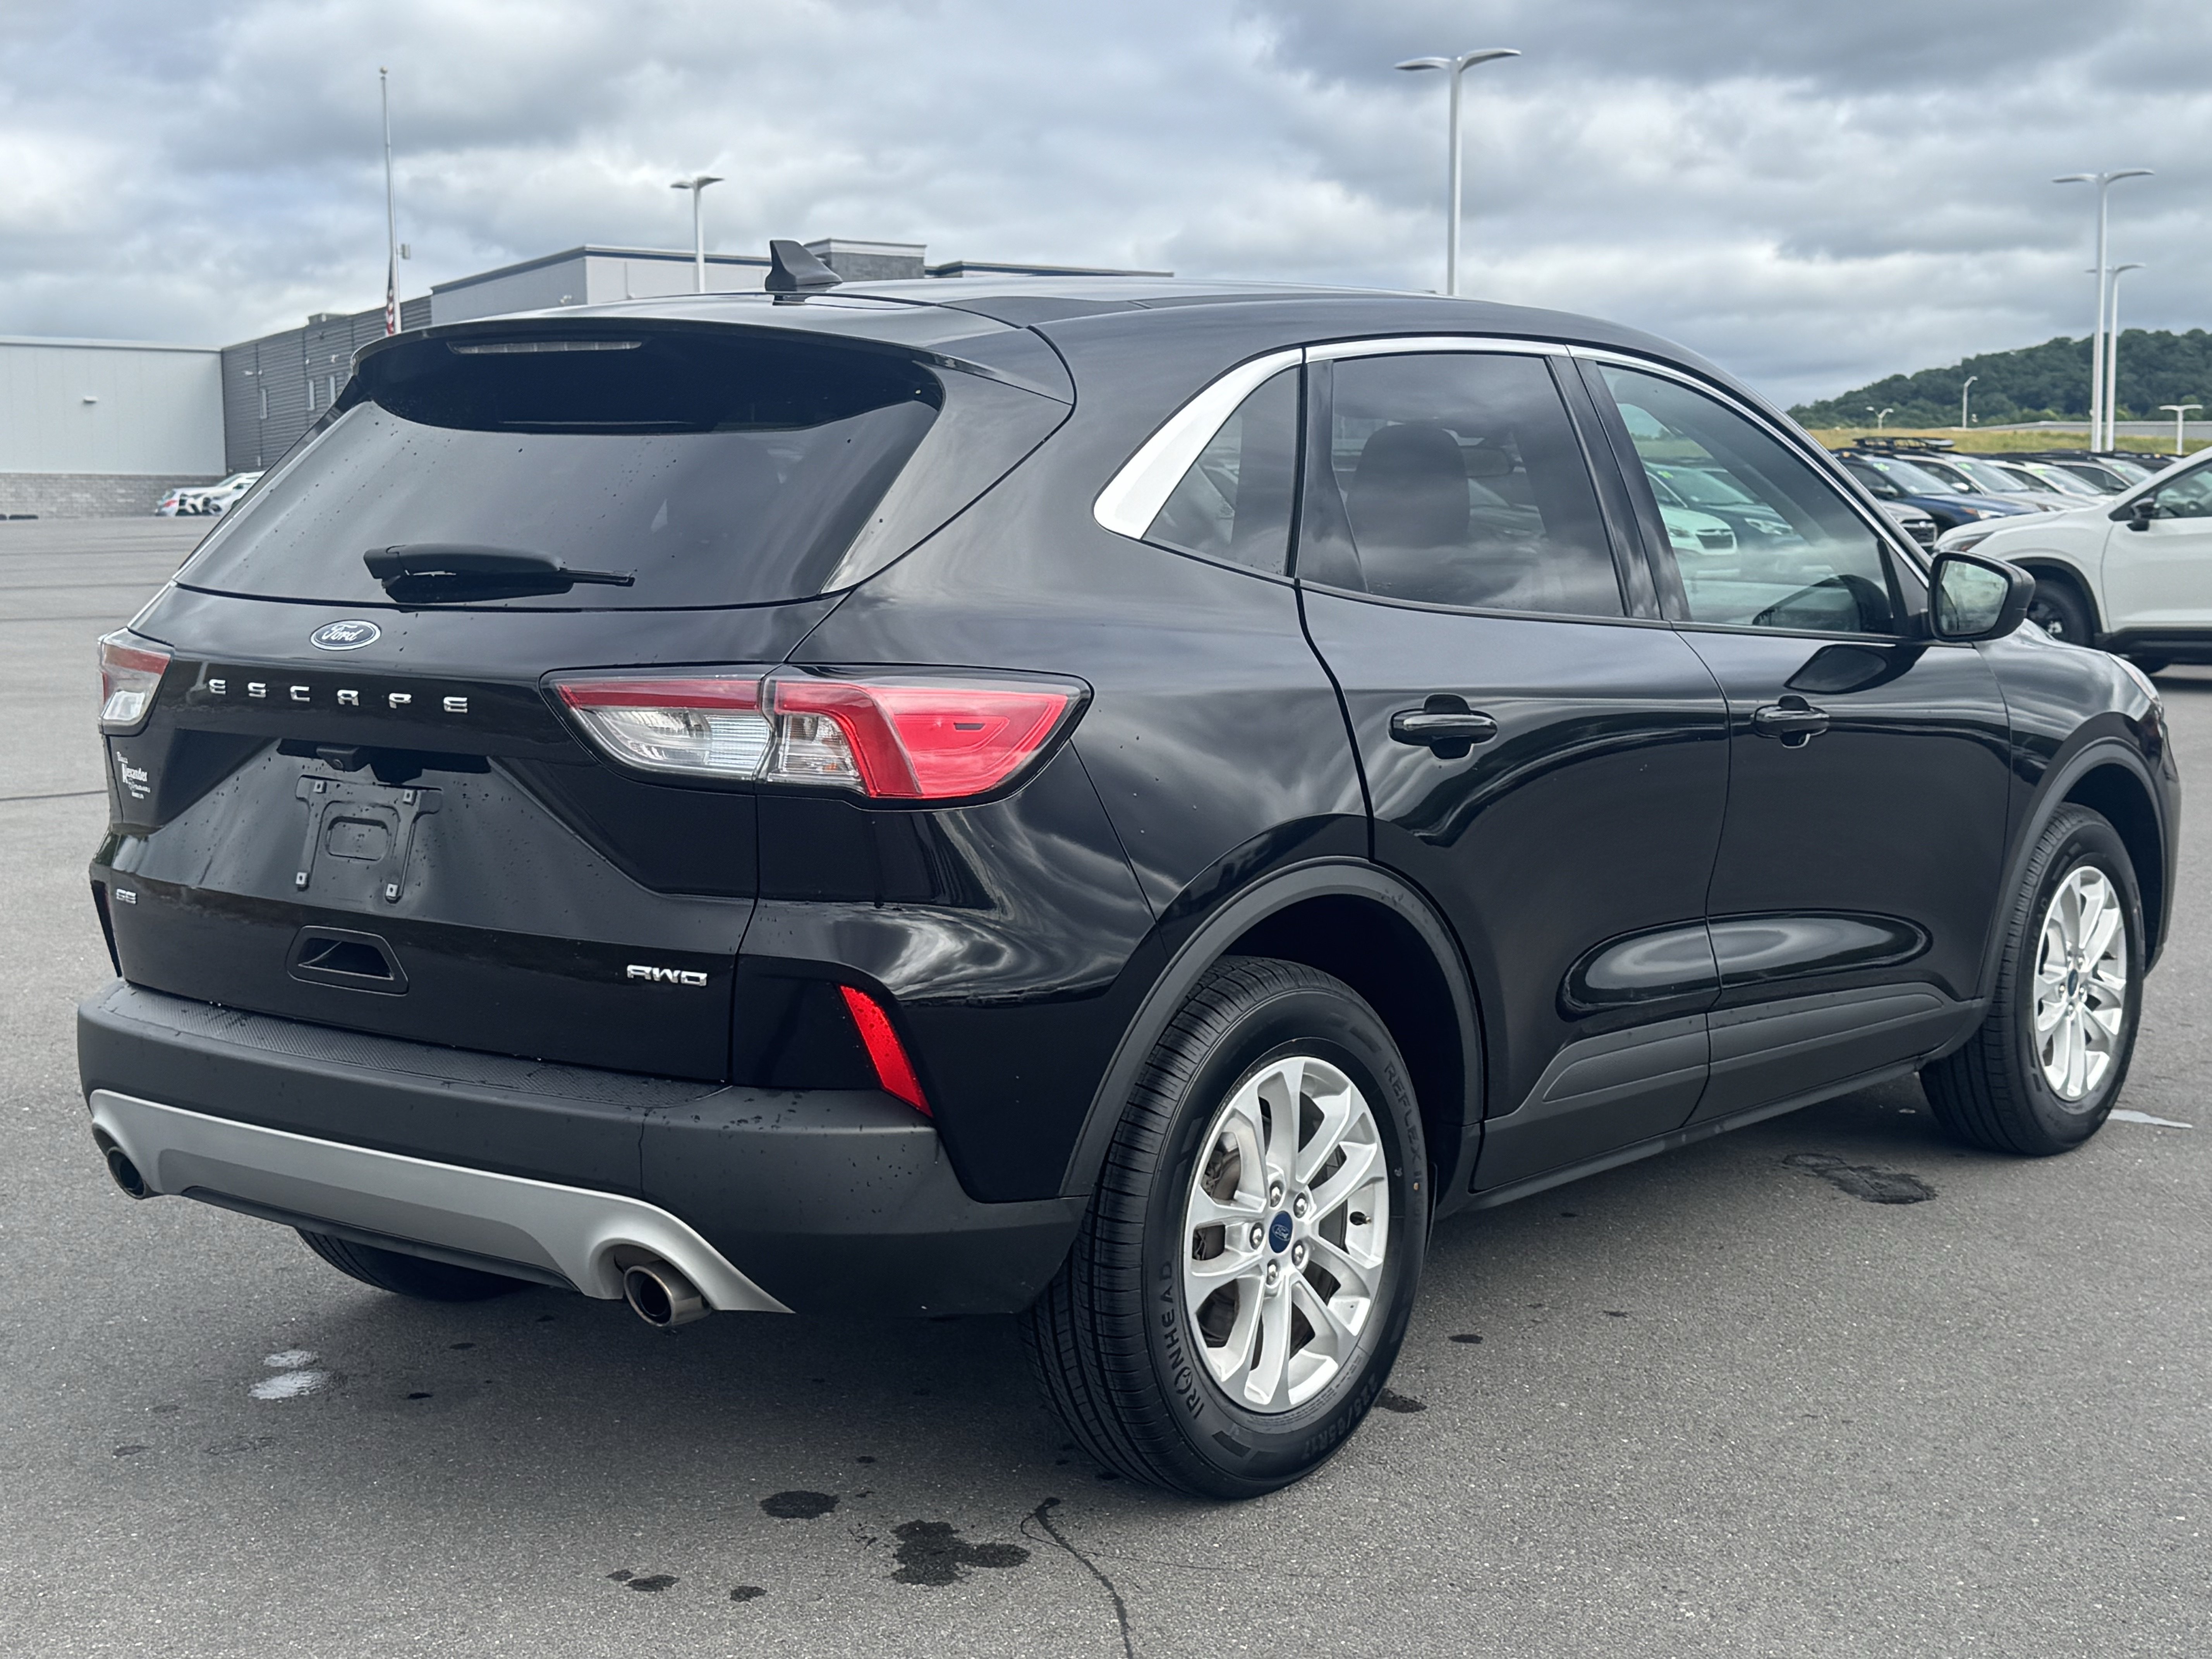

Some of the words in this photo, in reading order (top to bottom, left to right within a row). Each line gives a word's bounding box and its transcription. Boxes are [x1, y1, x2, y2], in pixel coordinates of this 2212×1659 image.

[321, 623, 363, 642] Ford
[208, 678, 468, 713] ESCAPE
[116, 888, 136, 905] SE
[627, 964, 708, 986] AWD
[1383, 1061, 1423, 1164] REFLEX
[1159, 1261, 1205, 1420] IRONHEAD
